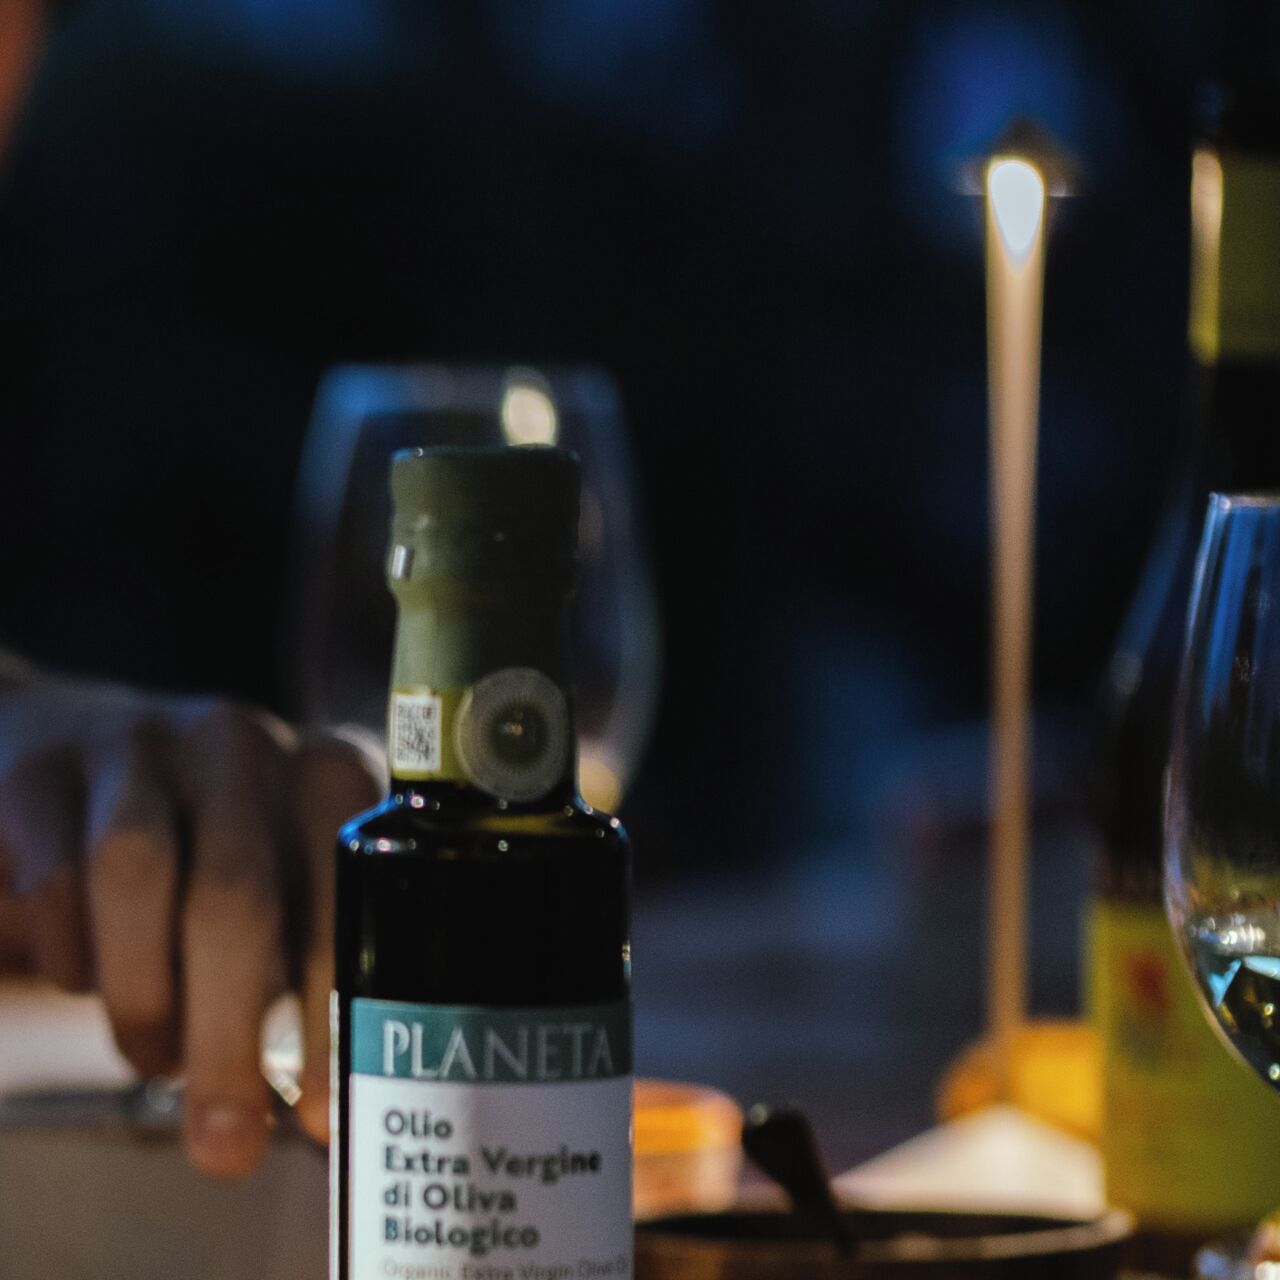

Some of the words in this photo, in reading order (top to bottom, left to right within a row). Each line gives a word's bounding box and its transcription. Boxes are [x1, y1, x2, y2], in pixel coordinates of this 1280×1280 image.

[383, 1020, 614, 1079] PLANETA
[385, 1110, 453, 1139] Olio
[385, 1146, 470, 1175] Extra
[481, 1145, 601, 1184] Vergine
[384, 1182, 410, 1206] di
[423, 1184, 517, 1212] Oliva
[385, 1217, 539, 1256] Biologico
